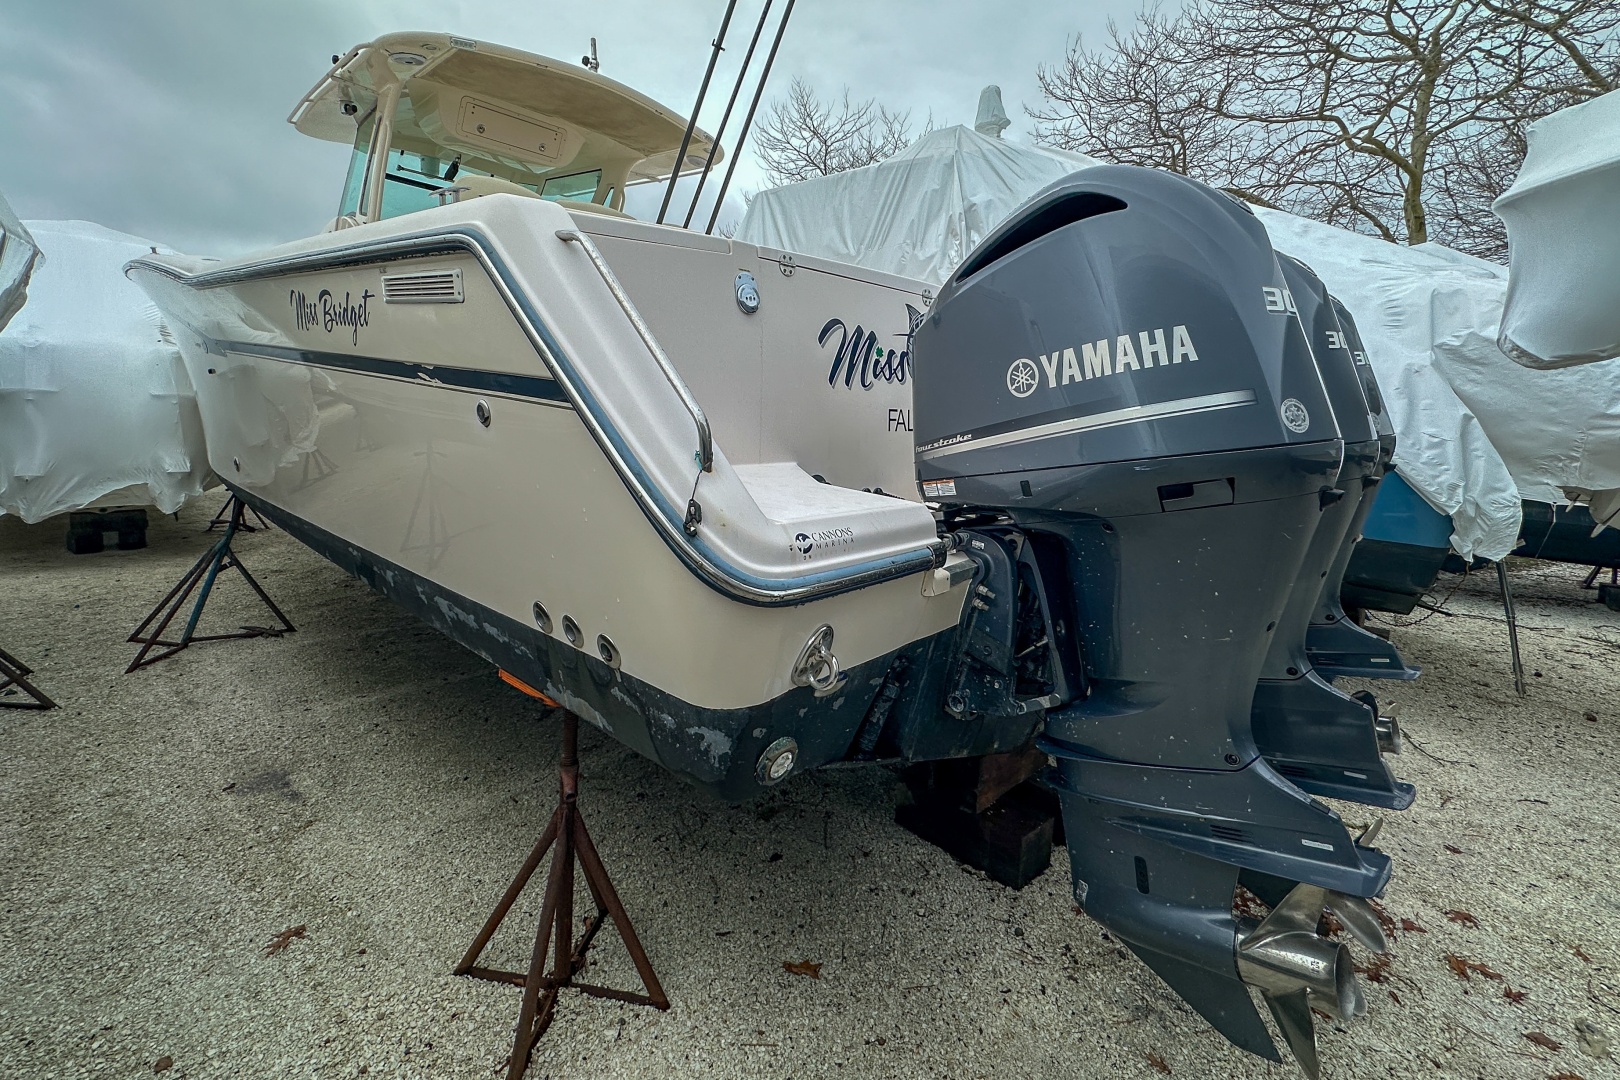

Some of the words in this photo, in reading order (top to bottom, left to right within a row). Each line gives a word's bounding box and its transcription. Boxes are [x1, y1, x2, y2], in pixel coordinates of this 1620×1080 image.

[290, 289, 318, 331] Miss
[319, 289, 375, 347] Bridget
[818, 318, 909, 391] Miss
[1039, 325, 1199, 388] YAMAHA
[811, 527, 854, 541] CANNONS
[815, 537, 854, 550] MARINA
